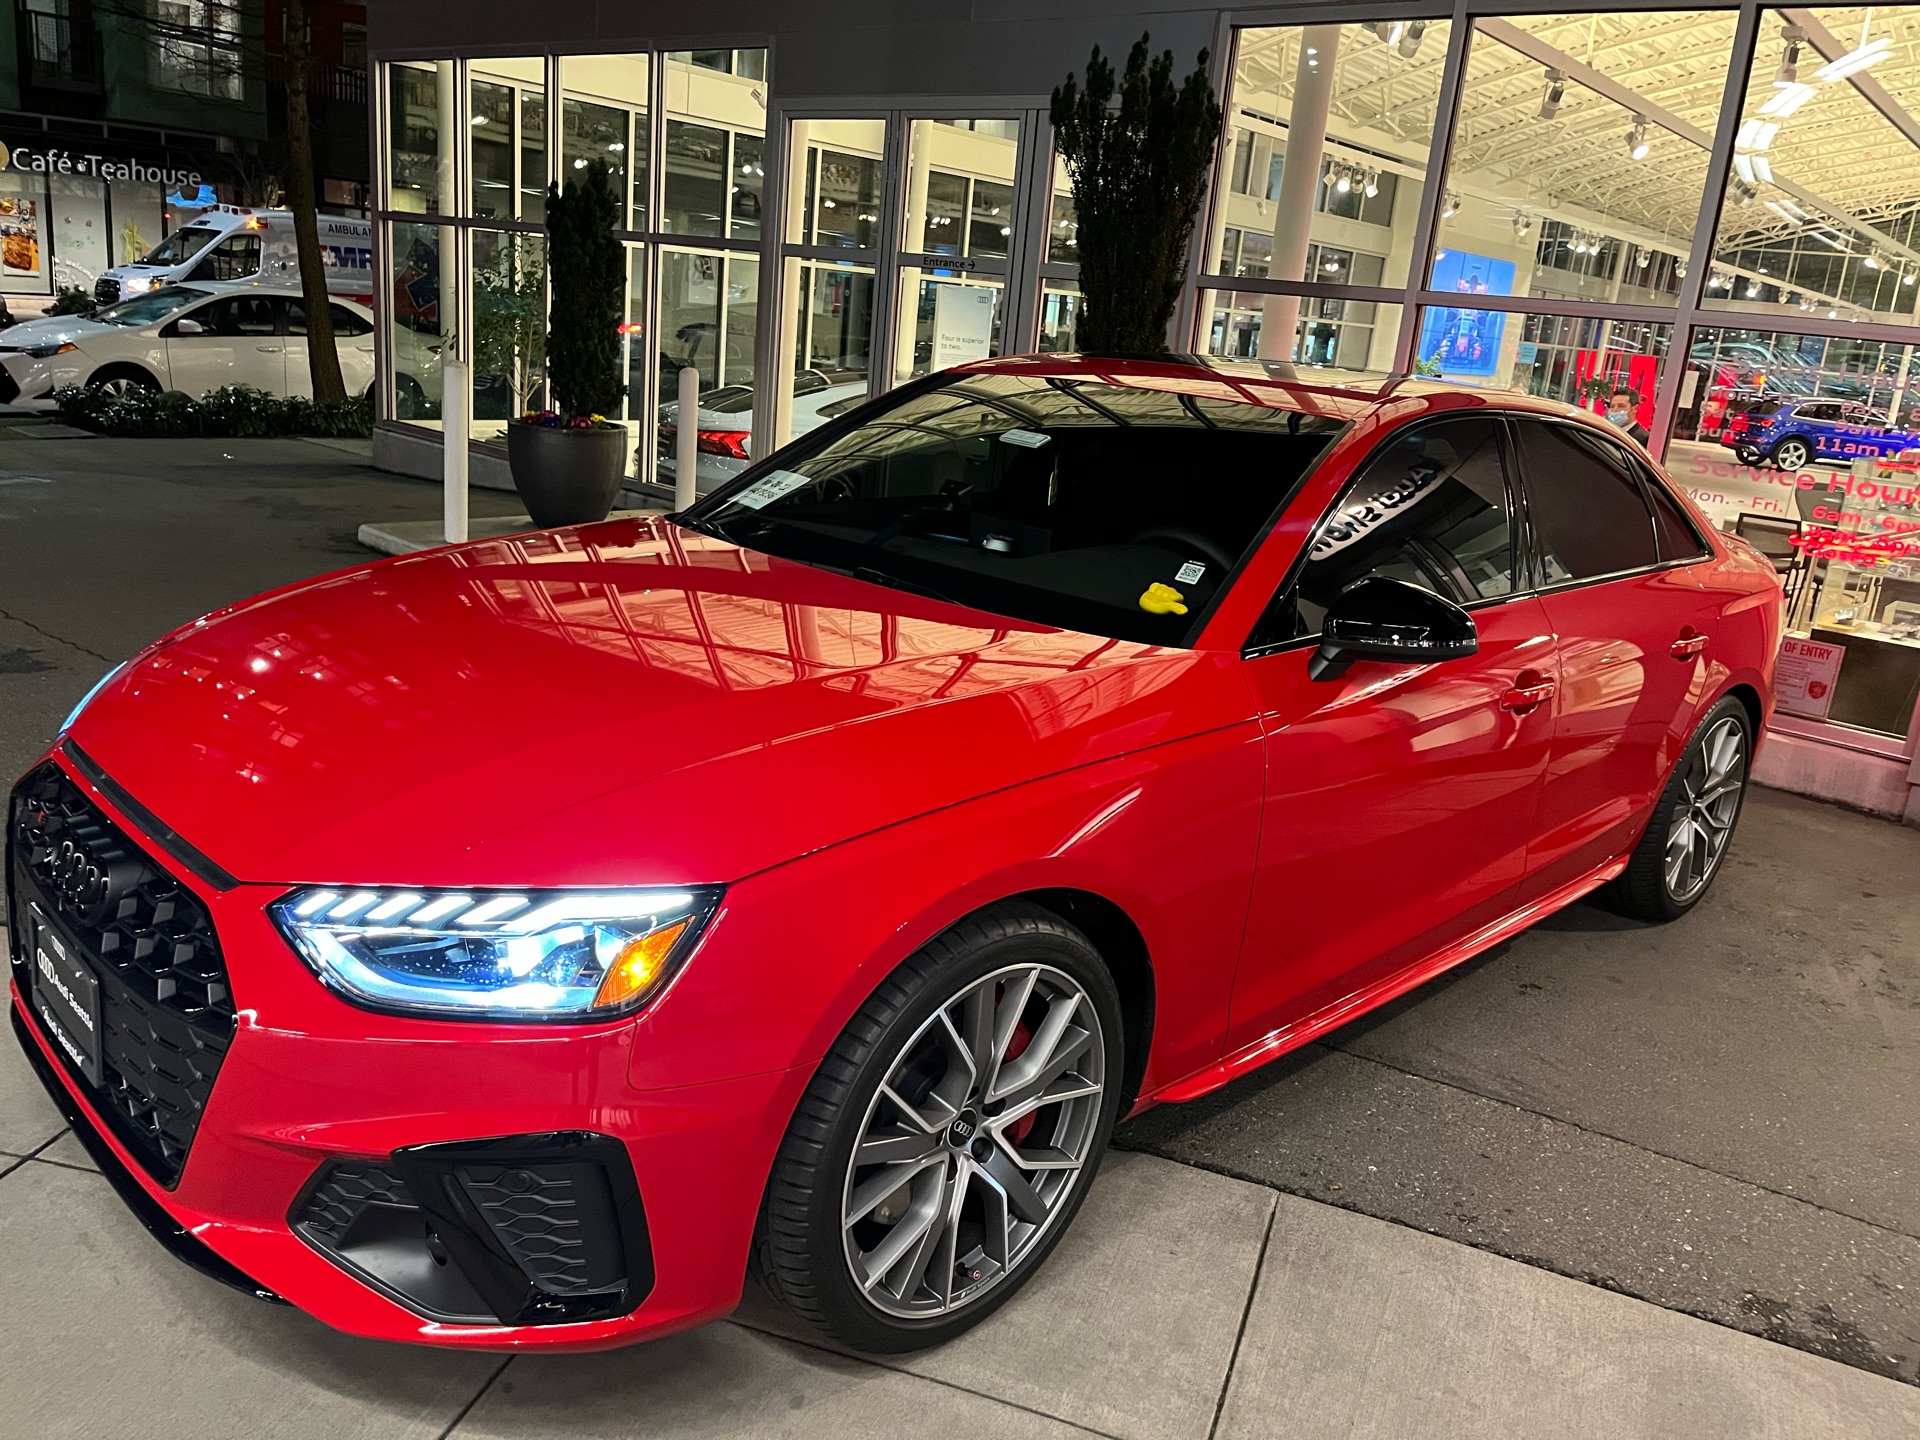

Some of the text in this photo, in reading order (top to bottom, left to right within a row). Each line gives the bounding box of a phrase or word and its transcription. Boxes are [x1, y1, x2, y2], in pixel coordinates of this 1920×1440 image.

[12, 148, 202, 187] Café Teahouse
[923, 256, 966, 268] Entrance
[941, 334, 955, 342] Four
[1732, 352, 1920, 394] Sales Hou
[1834, 419, 1886, 437] 9am
[1815, 436, 1880, 457] 11am
[1690, 454, 1816, 490] Service
[1751, 496, 1784, 512] Fri.
[1812, 505, 1862, 525] 6am
[1784, 641, 1833, 661] OF ENTRY
[54, 973, 94, 1032] Audi Seattle
